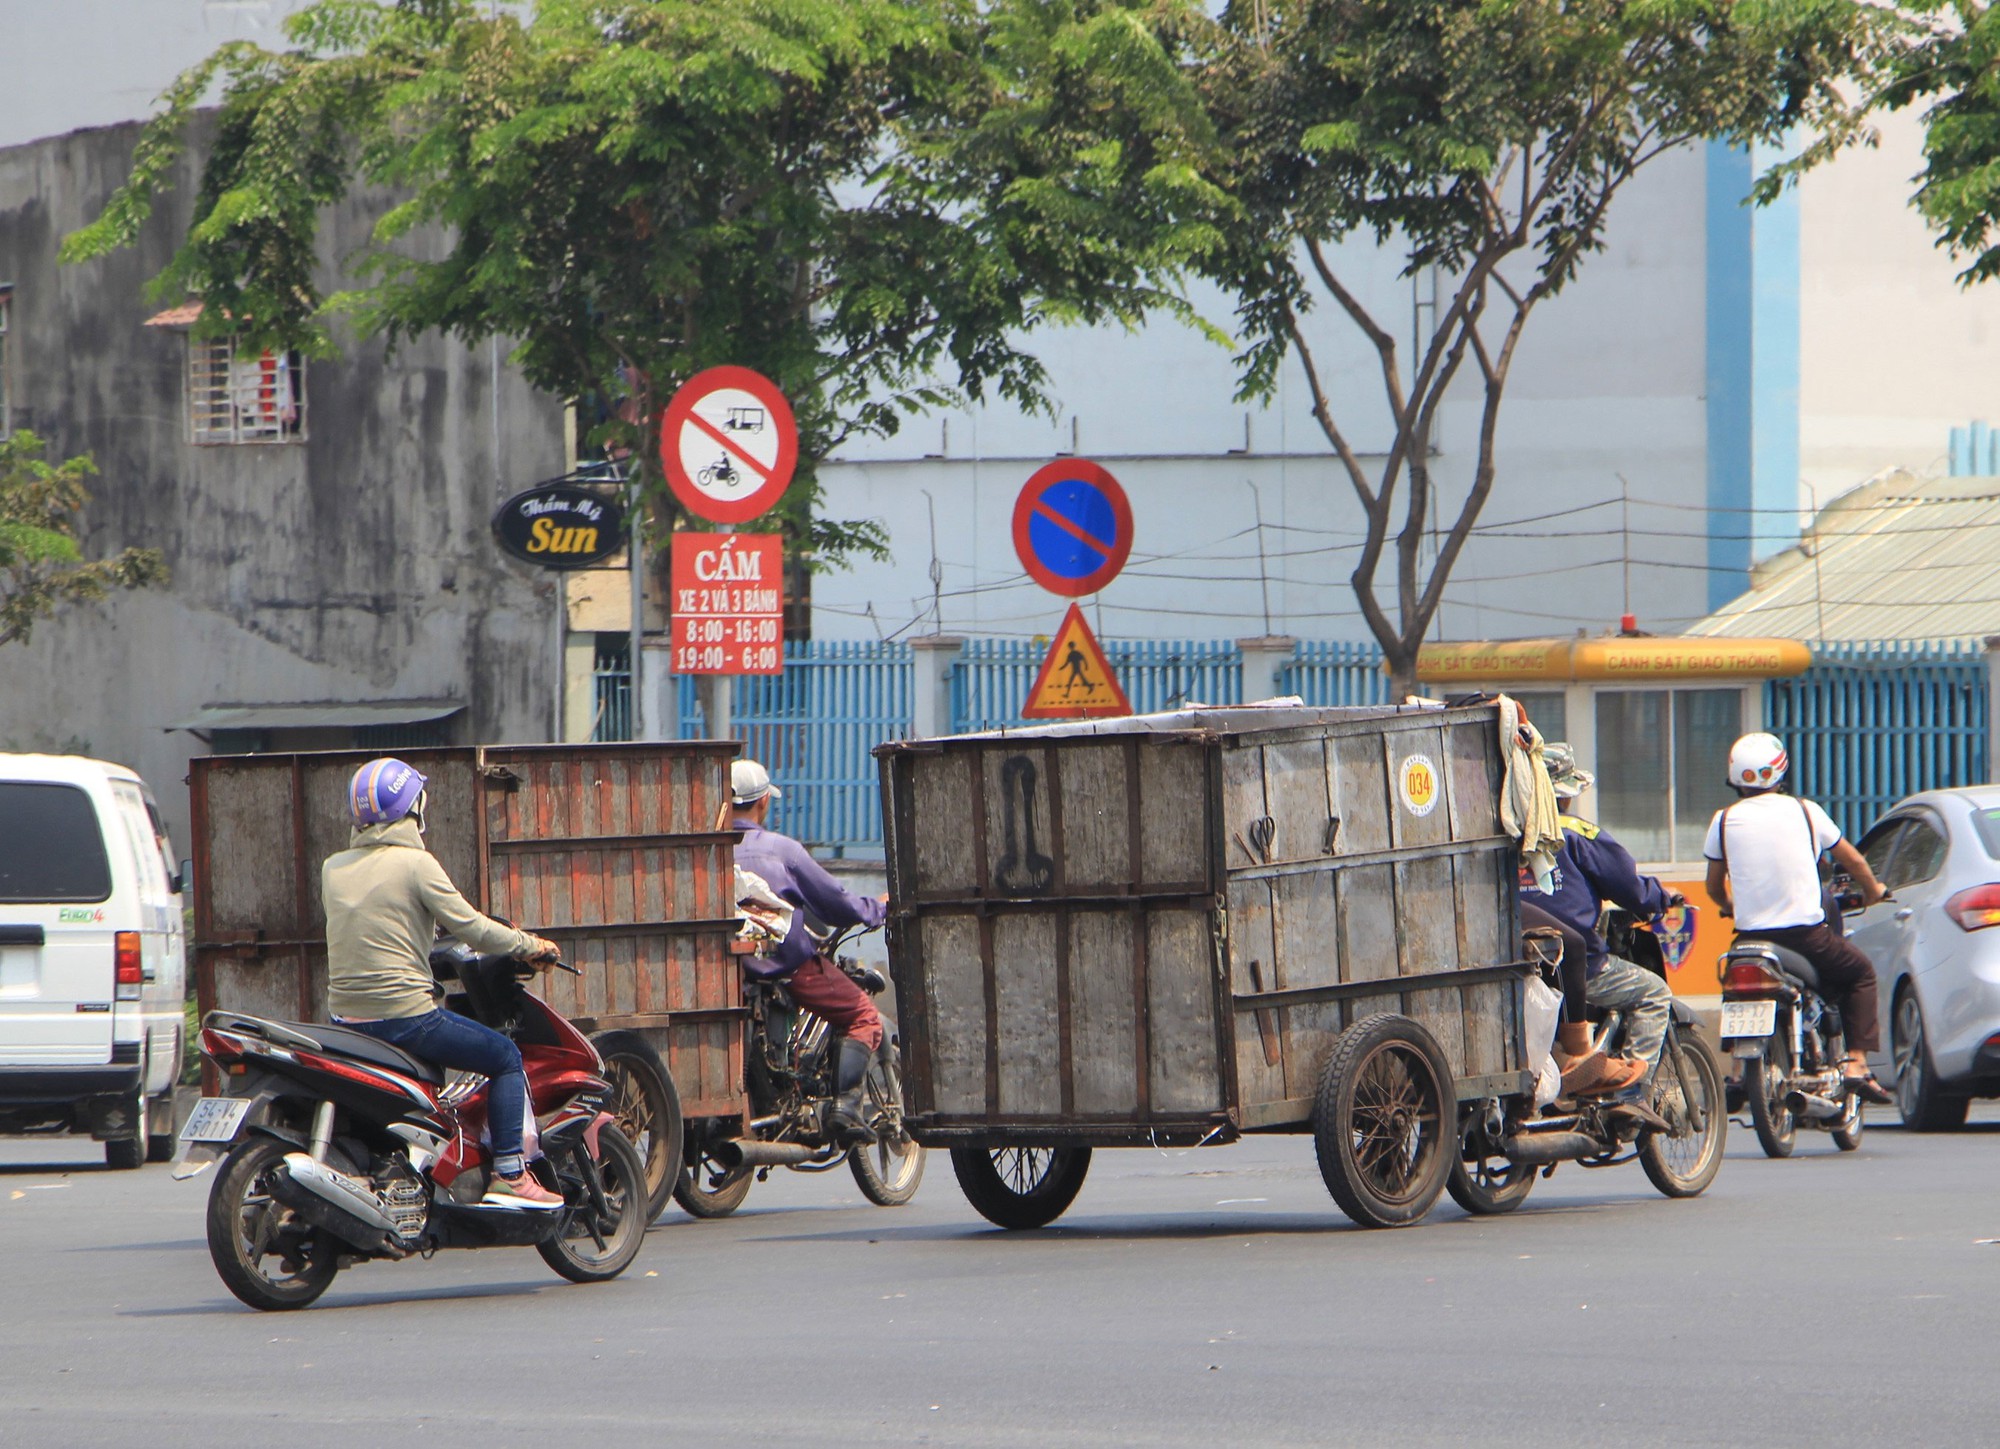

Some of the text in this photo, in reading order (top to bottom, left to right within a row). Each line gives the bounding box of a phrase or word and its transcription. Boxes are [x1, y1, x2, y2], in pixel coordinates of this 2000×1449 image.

[526, 517, 598, 553] Sun
[694, 535, 762, 581] CẤM
[678, 589, 697, 612] XE
[699, 589, 709, 612] 2
[732, 589, 741, 612] 3
[743, 584, 778, 612] BÁNH
[742, 646, 777, 669] 6:00
[1471, 655, 1500, 671] GIAO
[1687, 655, 1724, 670] GIAO
[1409, 772, 1431, 796] 034
[189, 1121, 229, 1138] 5011
